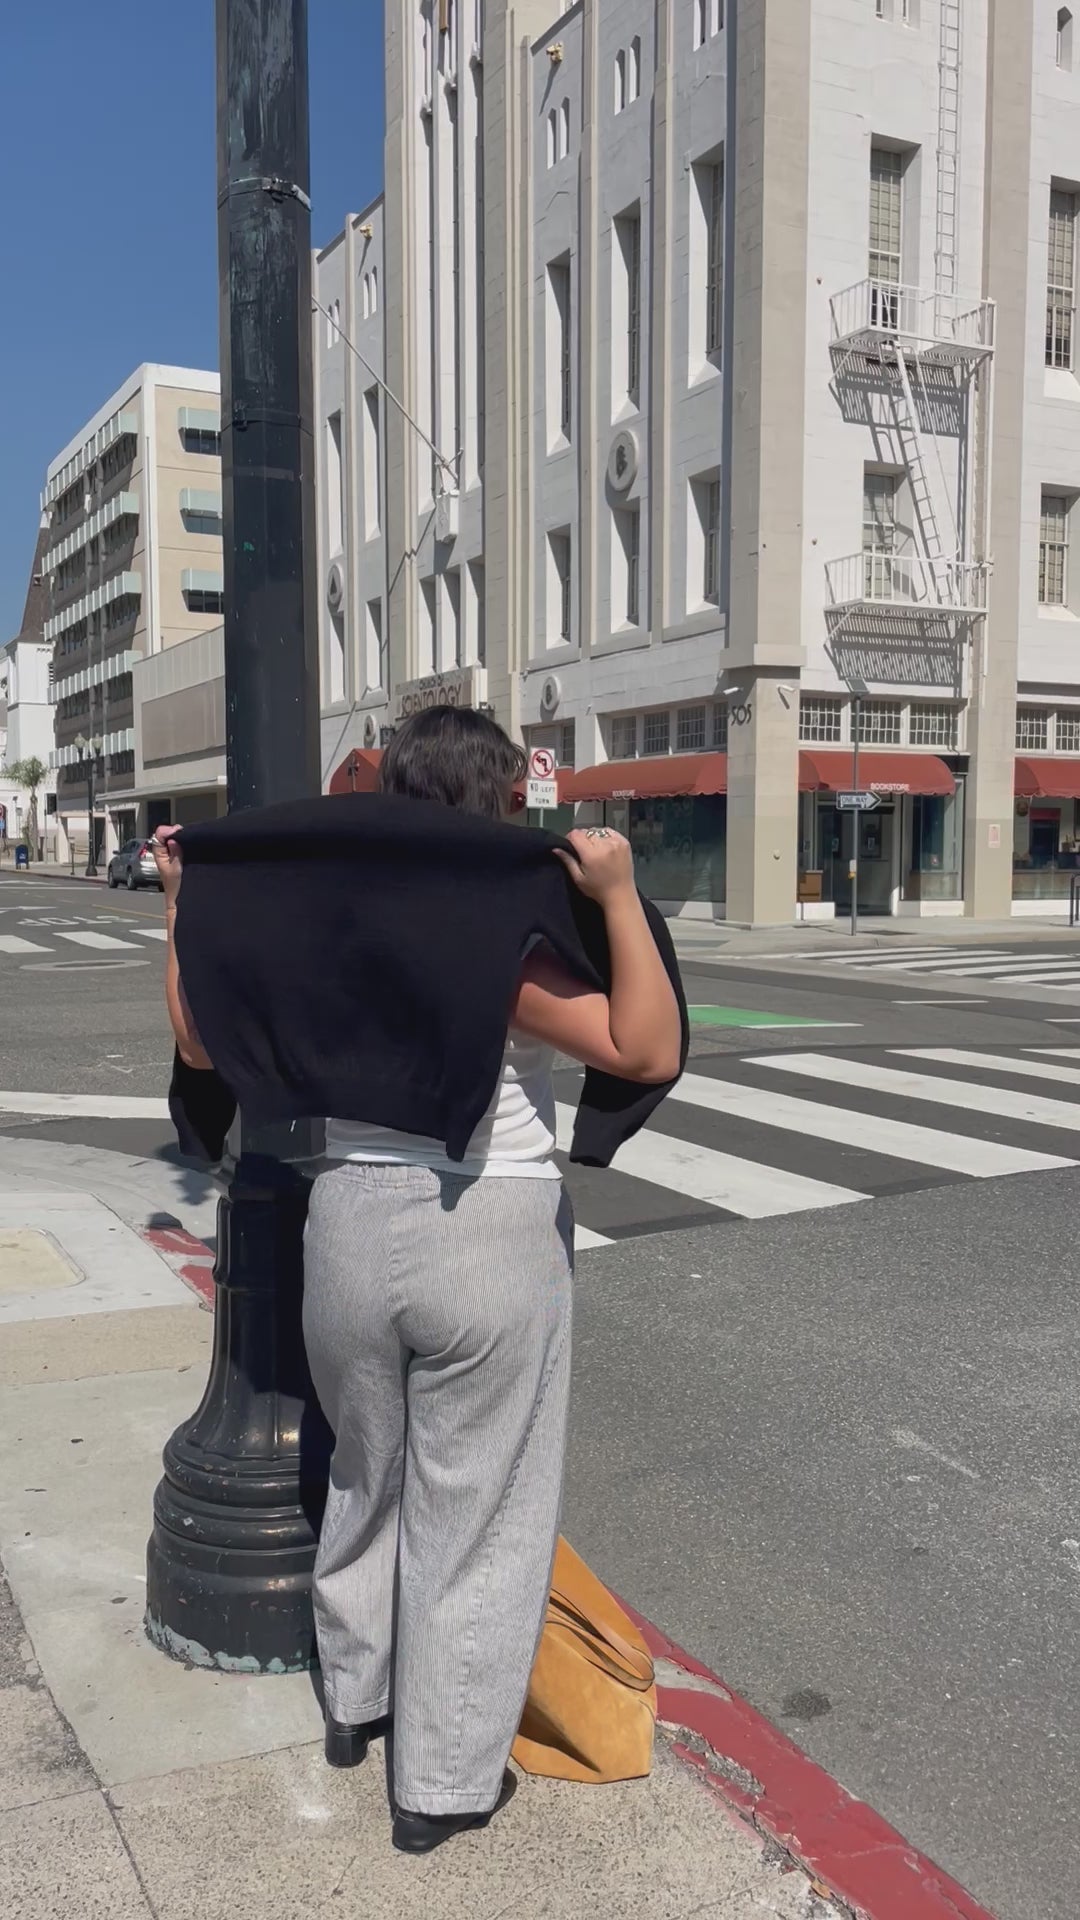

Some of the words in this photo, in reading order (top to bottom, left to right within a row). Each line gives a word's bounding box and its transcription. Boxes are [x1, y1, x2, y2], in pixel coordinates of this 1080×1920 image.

[730, 703, 752, 726] 505
[530, 783, 539, 792] NO
[870, 782, 910, 791] BOOKSTORE
[16, 915, 140, 927] STOP
